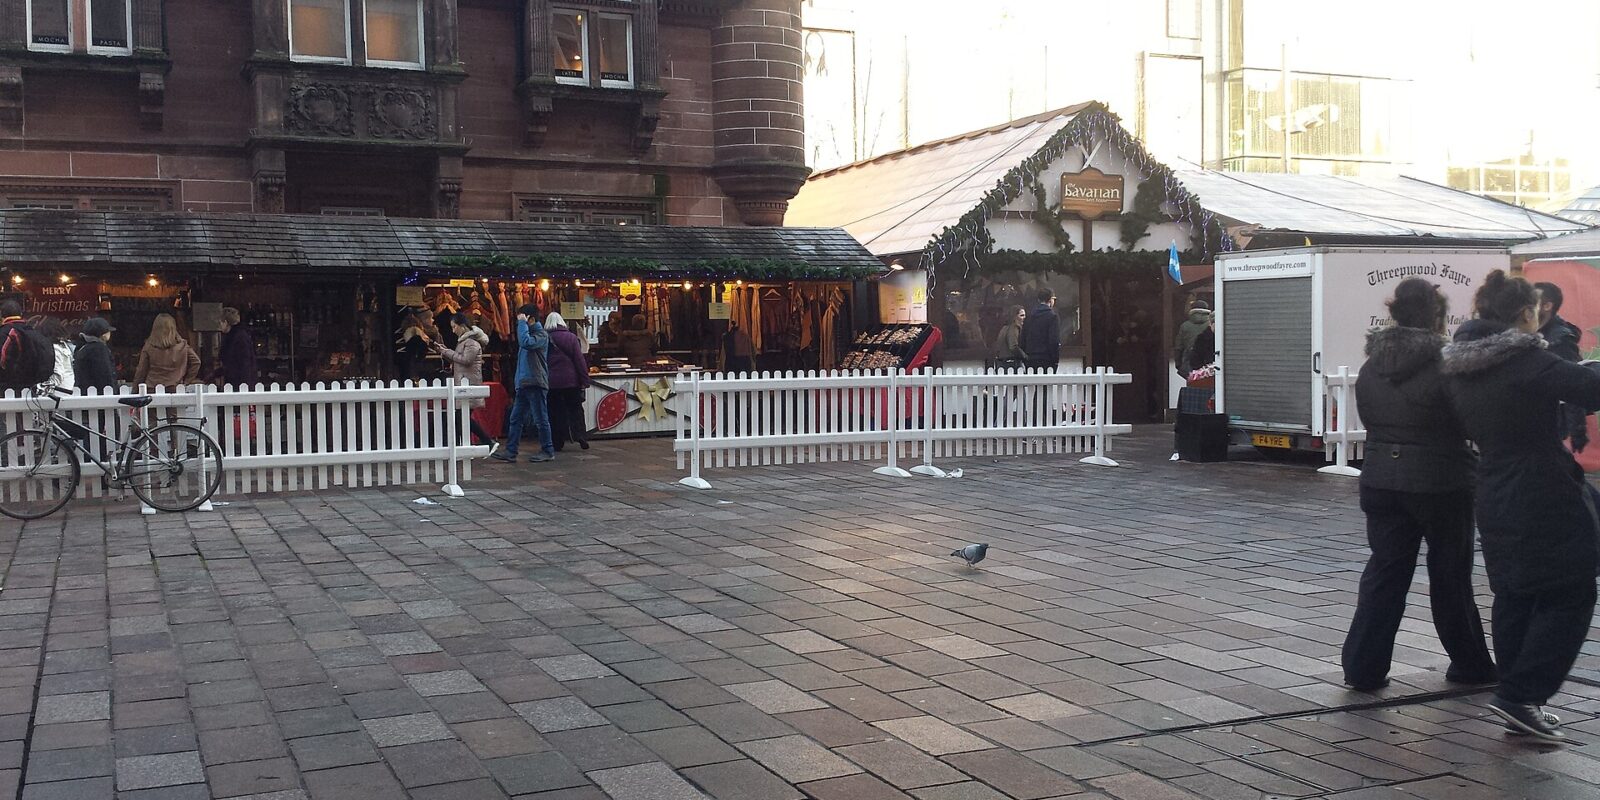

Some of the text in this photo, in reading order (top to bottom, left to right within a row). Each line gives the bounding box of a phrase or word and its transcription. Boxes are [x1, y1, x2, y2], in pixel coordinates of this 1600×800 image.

[1228, 262, 1307, 272] www.threepwoodfayre.com
[1367, 262, 1471, 286] Threepwood Fayre
[42, 287, 72, 295] MERRY
[1270, 436, 1284, 446] YRE
